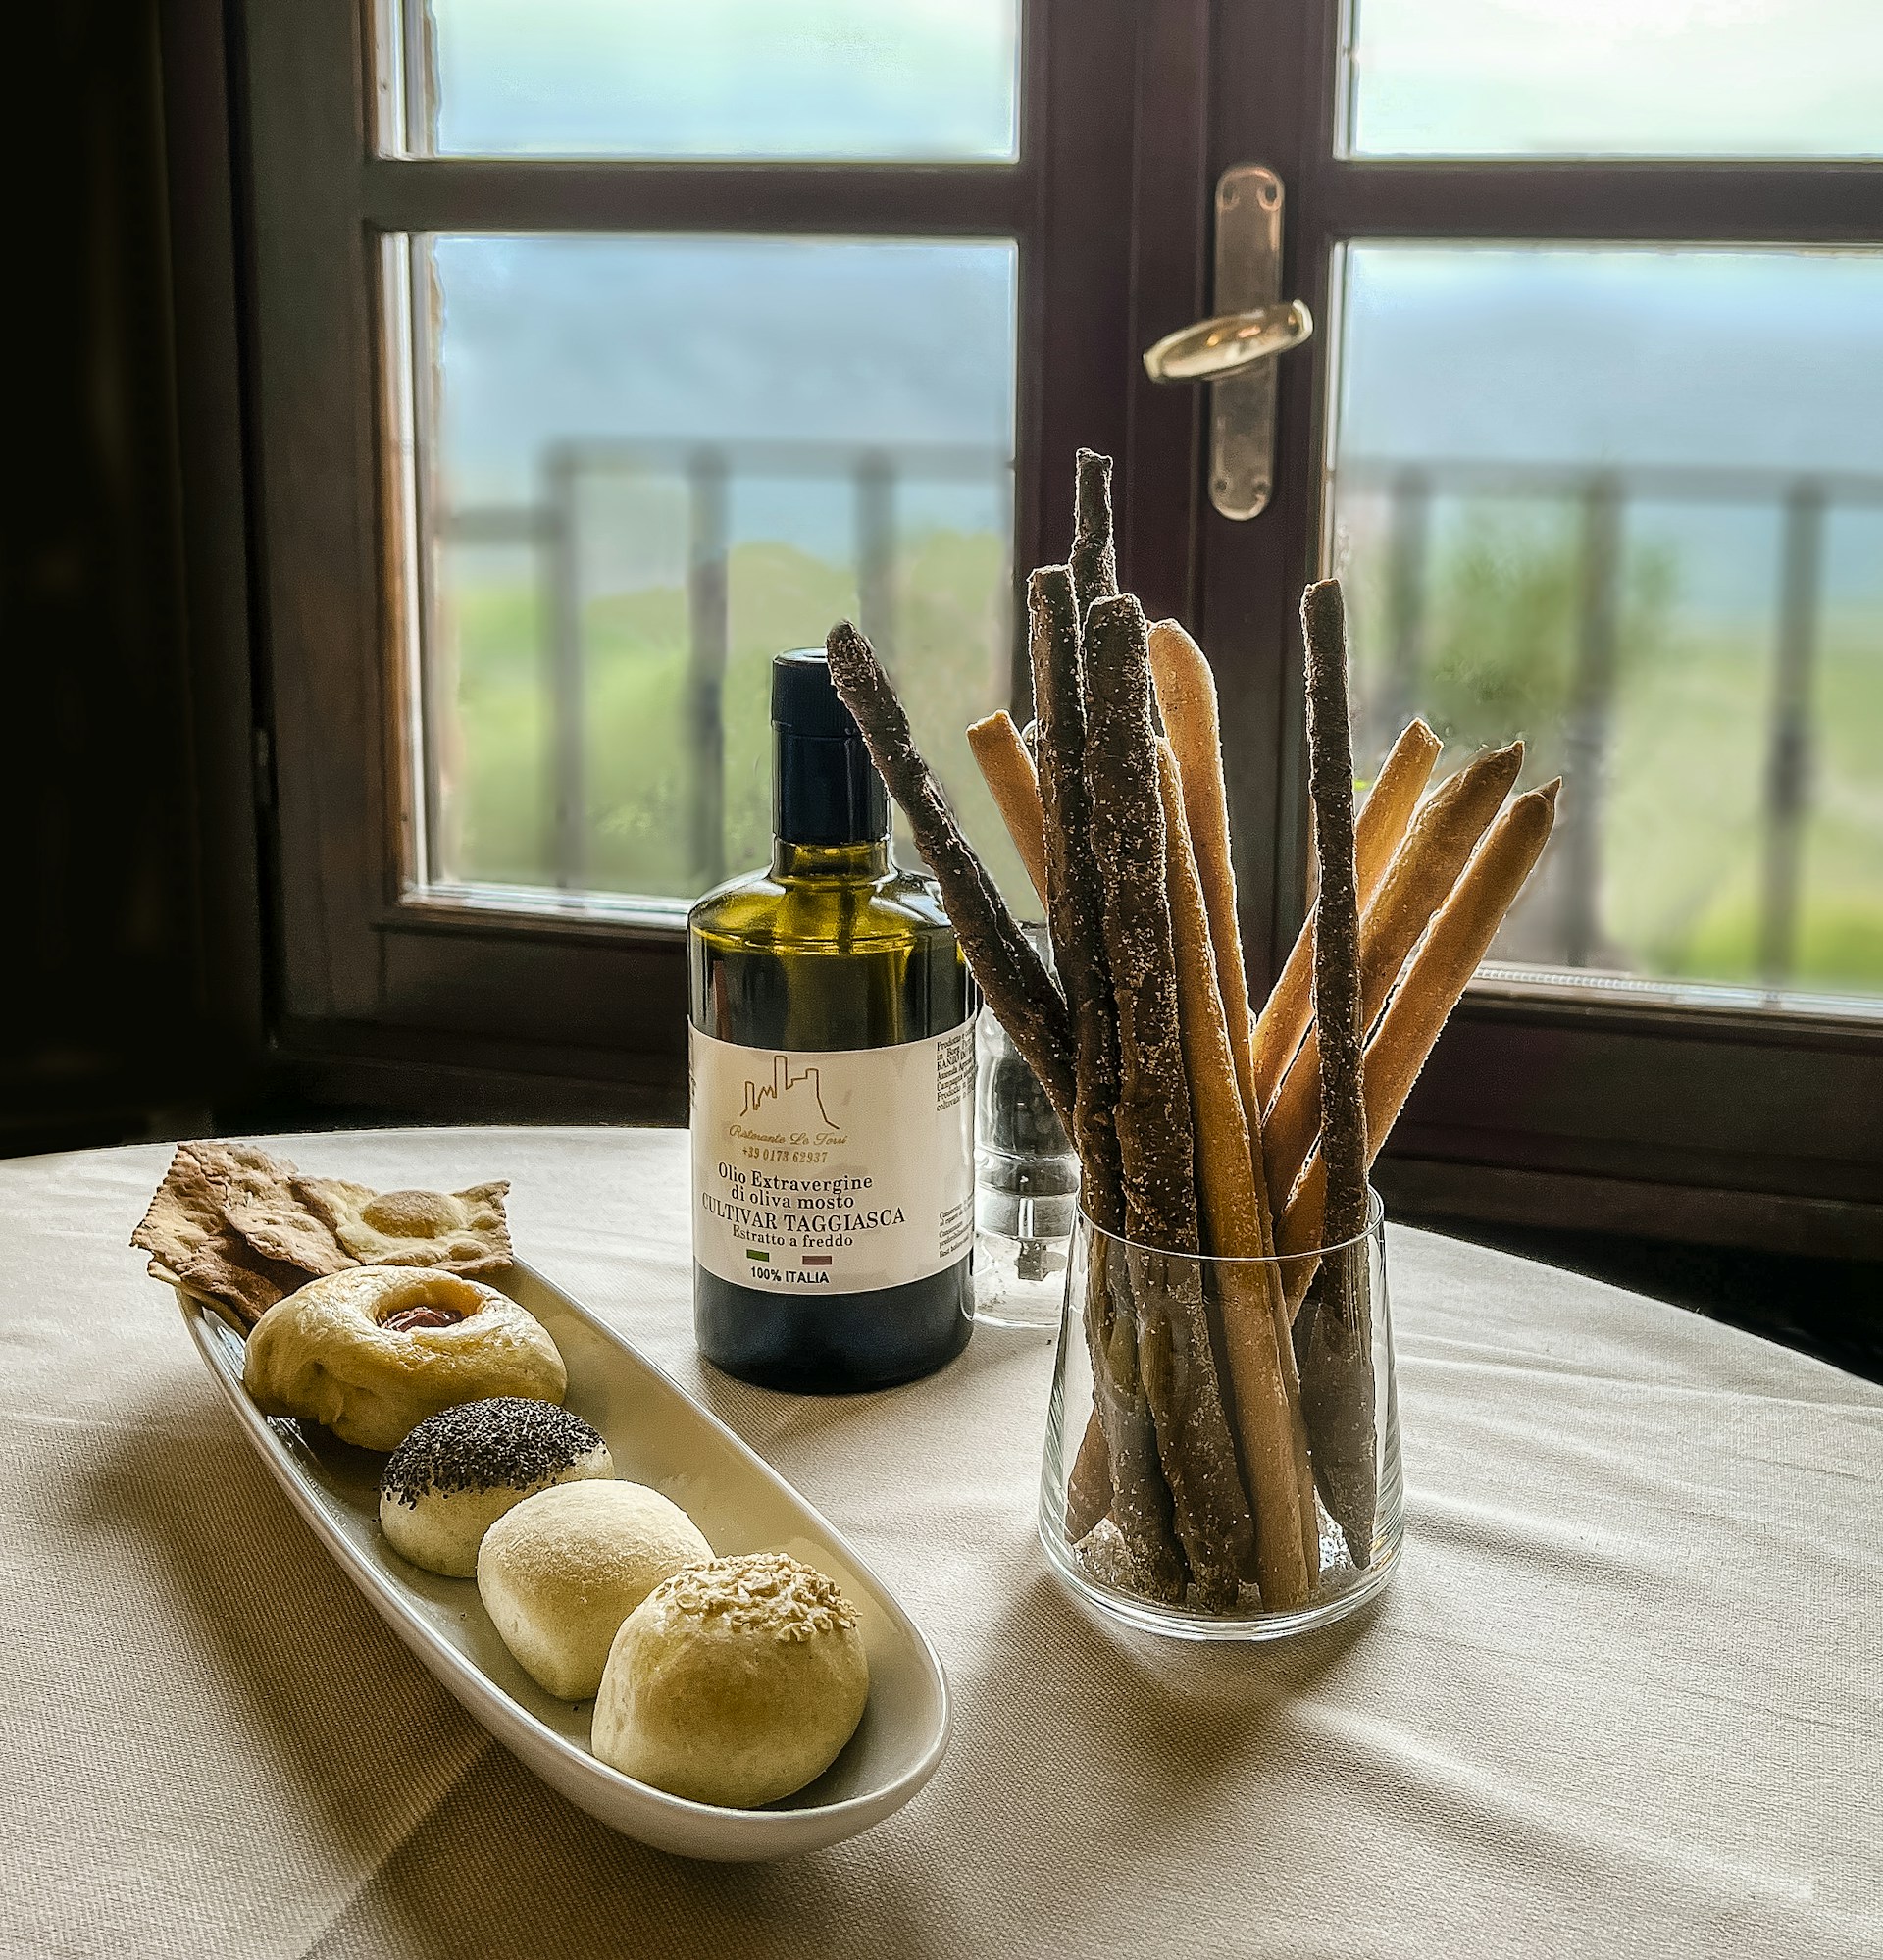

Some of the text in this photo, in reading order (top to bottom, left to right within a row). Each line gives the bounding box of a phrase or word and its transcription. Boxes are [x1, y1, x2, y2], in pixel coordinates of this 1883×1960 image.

[729, 1124, 786, 1144] Ristorante
[789, 1132, 810, 1145] Le
[742, 1146, 829, 1163] +39 0173 62937
[718, 1161, 873, 1194] Olio Extravergine
[732, 1185, 854, 1209] di oliva mosto
[702, 1191, 778, 1230] CULTIVAR
[784, 1207, 906, 1232] TAGGIASCA
[733, 1224, 853, 1248] Estratto a freddo
[751, 1266, 830, 1284] 100% ITALIA
